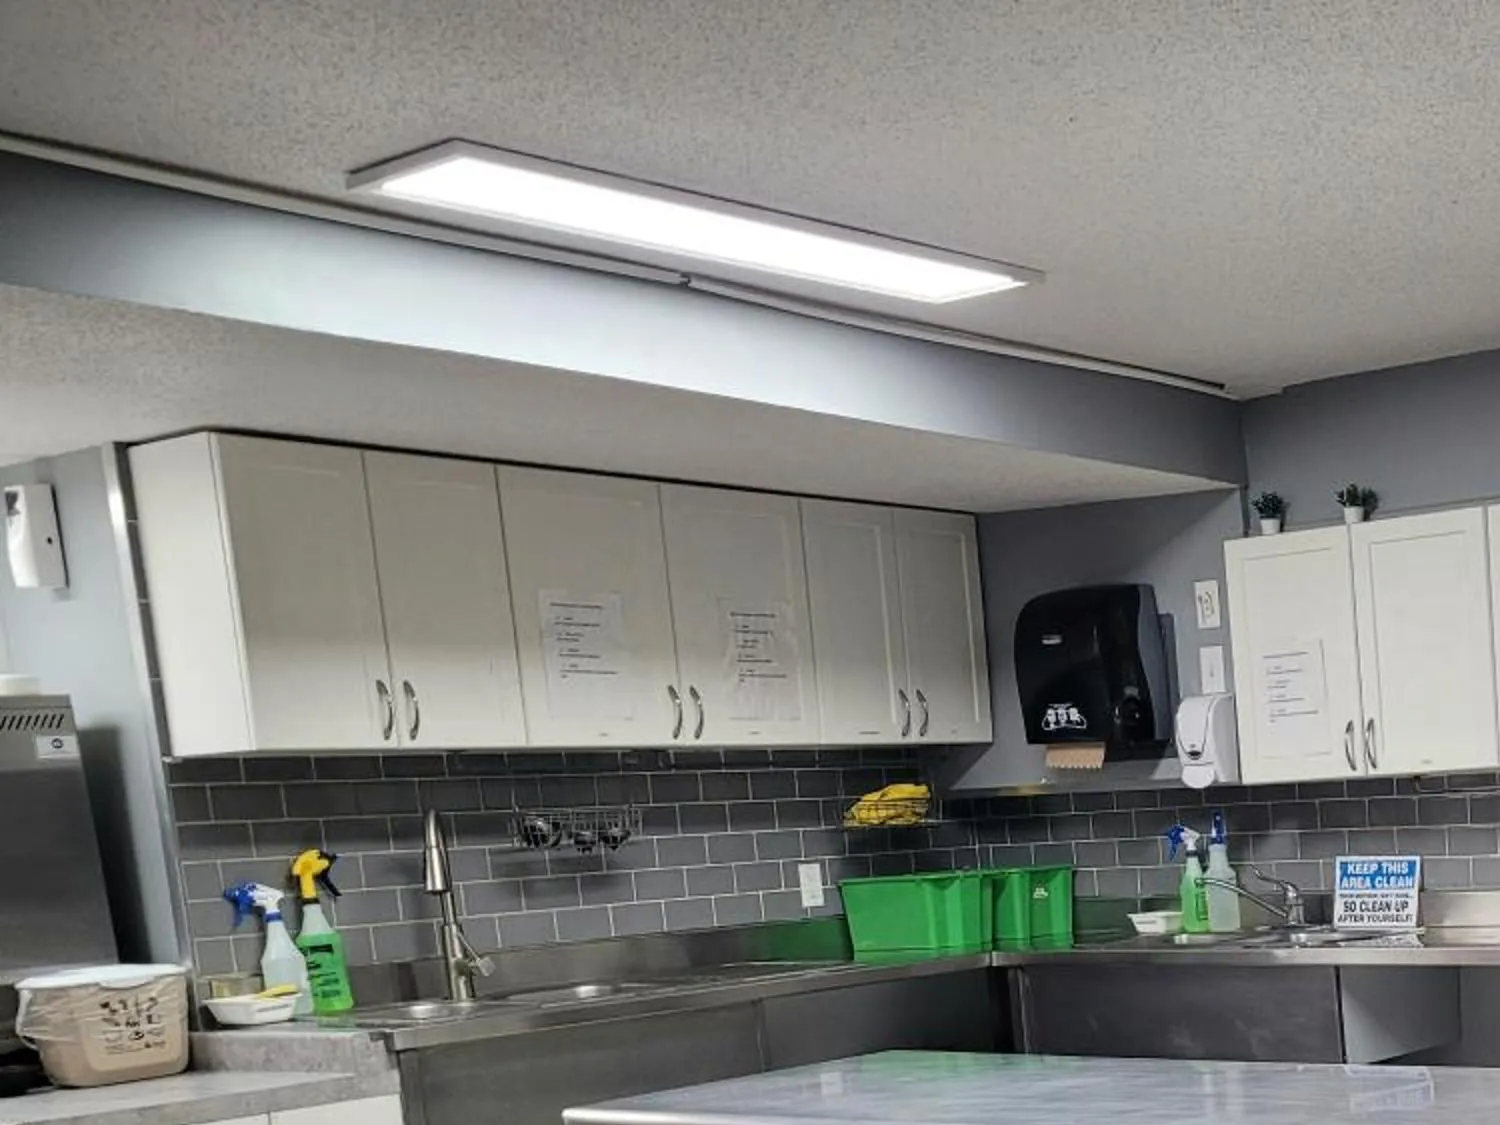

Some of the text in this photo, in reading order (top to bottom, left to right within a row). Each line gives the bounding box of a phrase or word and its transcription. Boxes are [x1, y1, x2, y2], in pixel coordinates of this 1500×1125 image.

[1347, 861, 1409, 875] KEEP THIS
[1341, 875, 1413, 889] AREA CLEAN
[1343, 900, 1409, 913] SO CLEAN UP
[1337, 913, 1364, 923] AFTER
